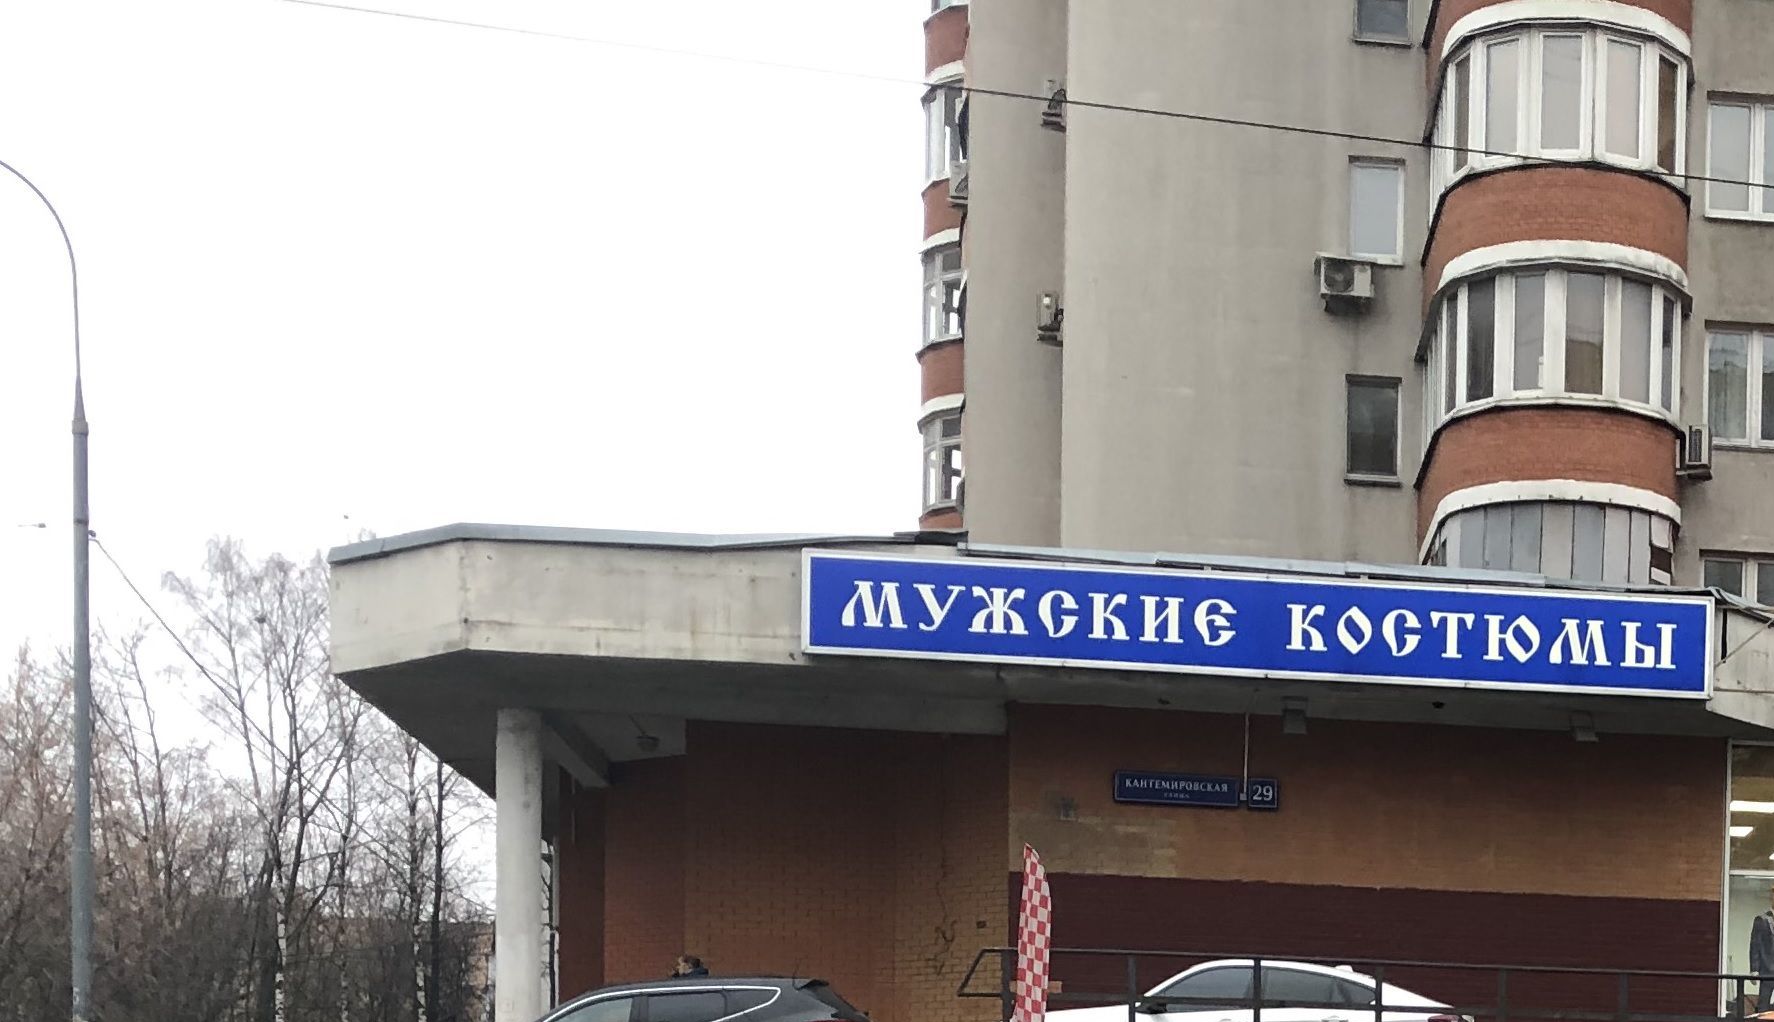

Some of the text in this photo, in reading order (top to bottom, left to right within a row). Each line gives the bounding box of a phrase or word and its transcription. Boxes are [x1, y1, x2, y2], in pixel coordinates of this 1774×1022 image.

[841, 580, 1678, 670] МУЖСКИЕ КОСТЮМЫ
[1125, 778, 1228, 793] КАНТЕМИРОВСКАЯ
[1252, 784, 1274, 801] 29
